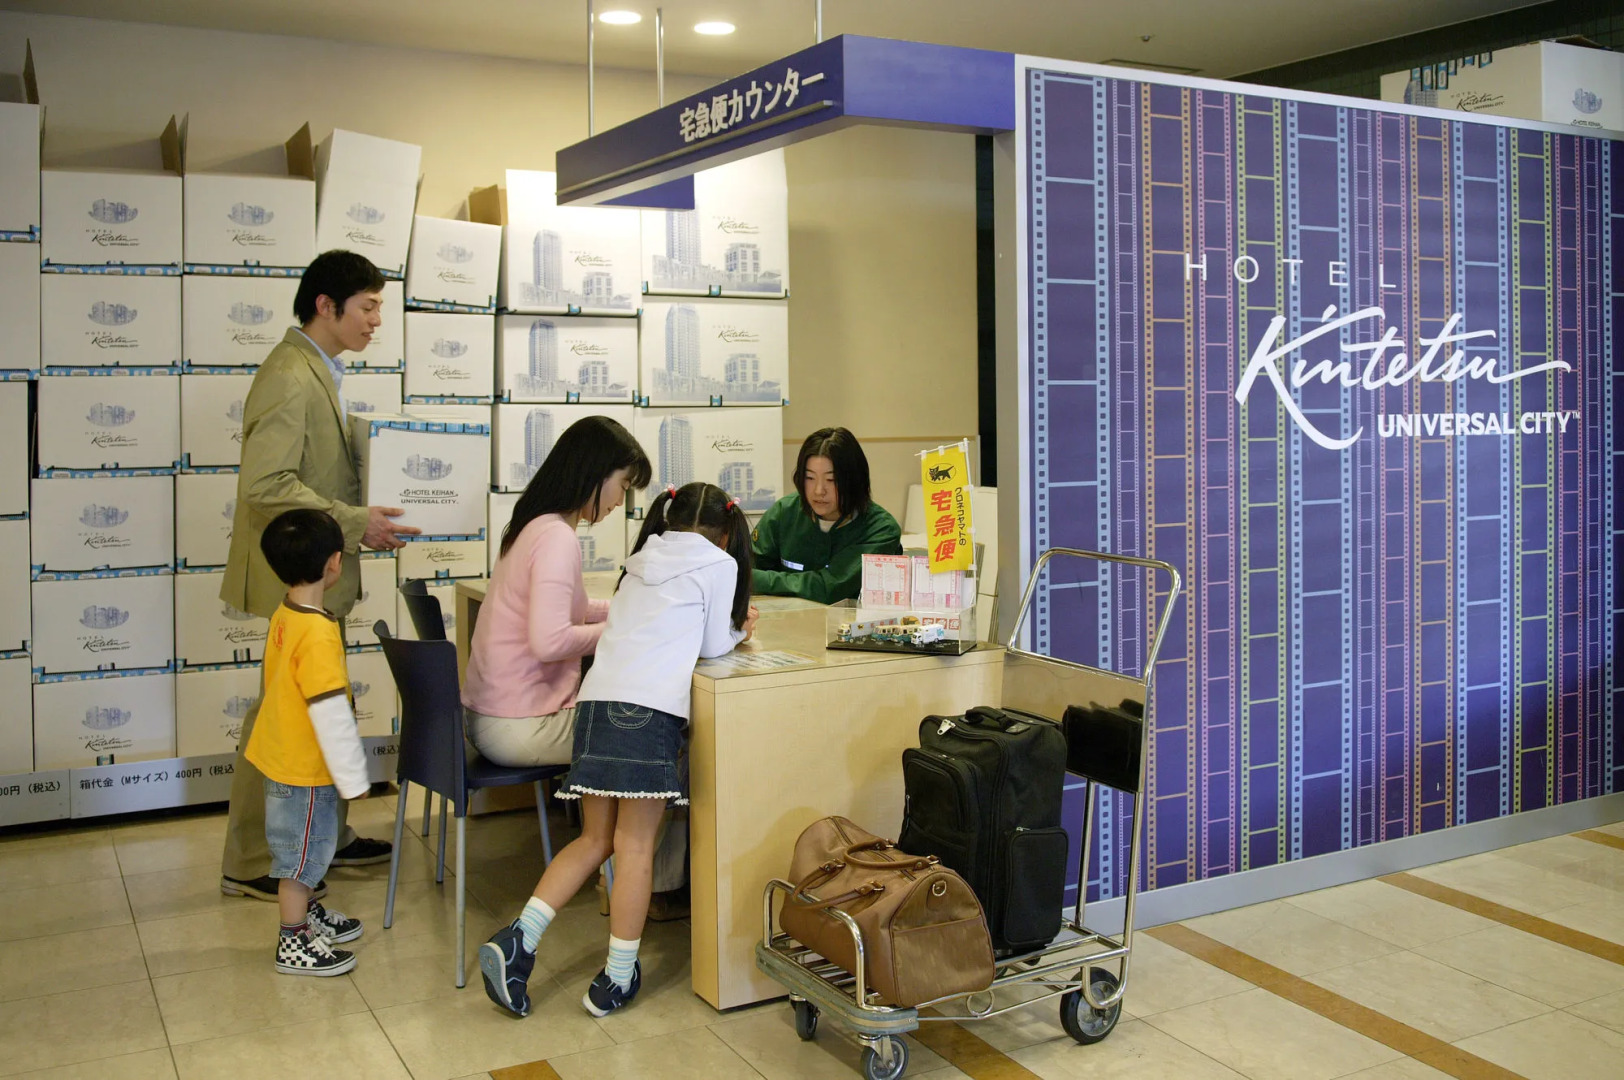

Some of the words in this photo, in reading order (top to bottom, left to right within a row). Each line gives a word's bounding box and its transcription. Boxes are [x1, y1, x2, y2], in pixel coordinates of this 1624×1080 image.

[679, 67, 824, 142] 宅急便カウンター
[1185, 254, 1397, 288] HOTEL
[1235, 305, 1571, 449] Kintetsu
[1377, 414, 1514, 438] UNIVERSAL
[930, 489, 958, 563] 宅急便
[955, 486, 967, 546] クロネコヤマトの
